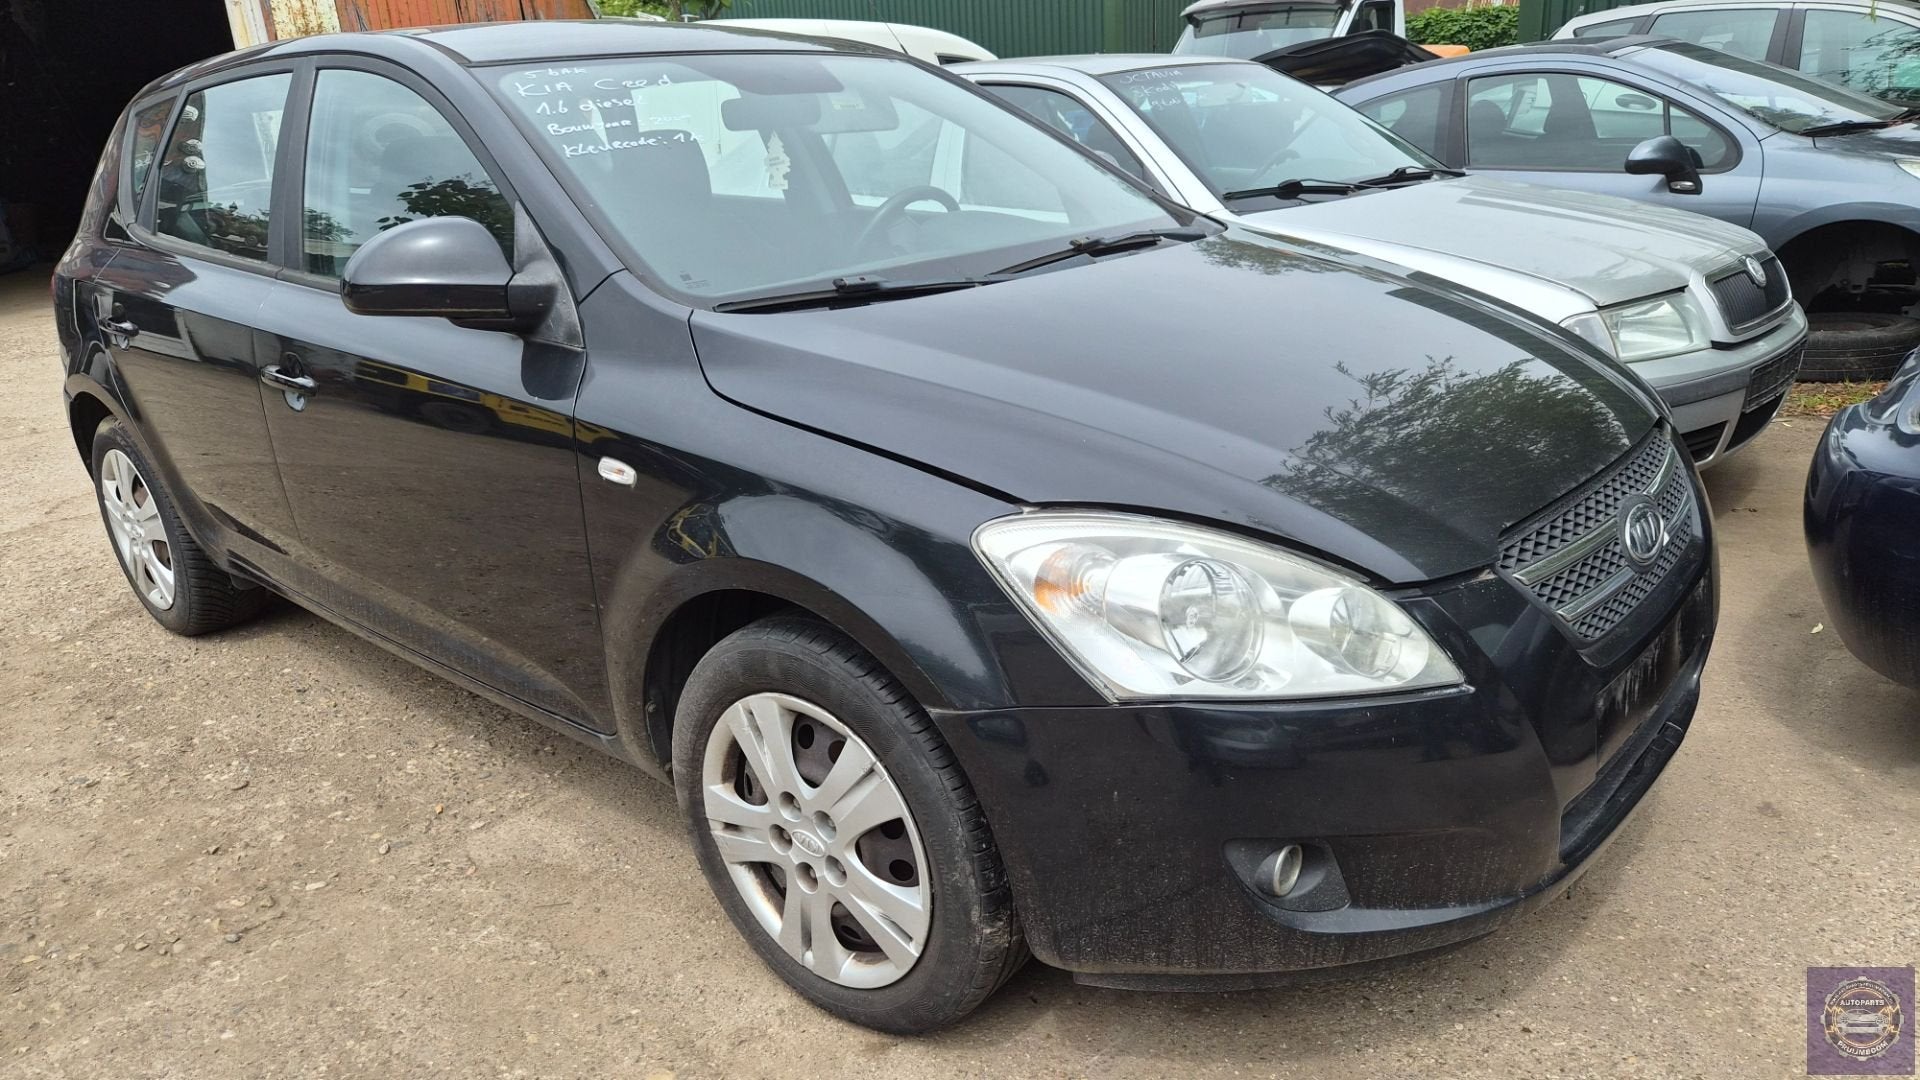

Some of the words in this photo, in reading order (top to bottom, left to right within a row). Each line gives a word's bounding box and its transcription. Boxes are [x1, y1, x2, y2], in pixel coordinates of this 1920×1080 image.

[515, 82, 572, 97] KIA
[536, 100, 568, 115] 1.6
[579, 95, 649, 111] diesel
